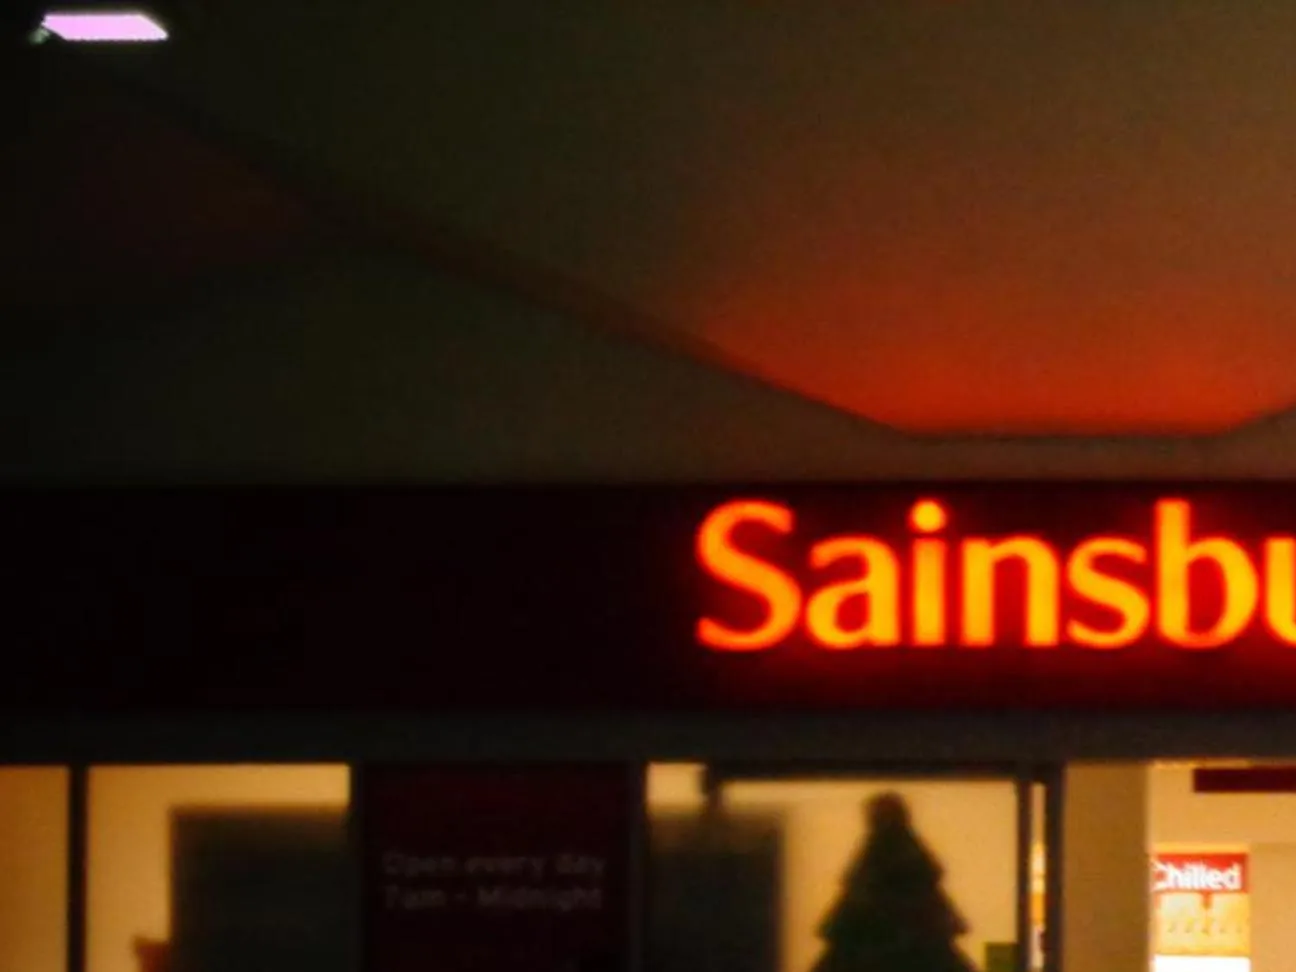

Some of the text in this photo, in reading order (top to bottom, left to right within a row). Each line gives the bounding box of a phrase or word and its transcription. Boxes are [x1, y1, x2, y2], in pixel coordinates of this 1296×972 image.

[382, 849, 607, 880] Open every day
[1152, 860, 1242, 890] Chilled
[383, 885, 447, 911] 7am
[477, 886, 603, 913] Midnight
